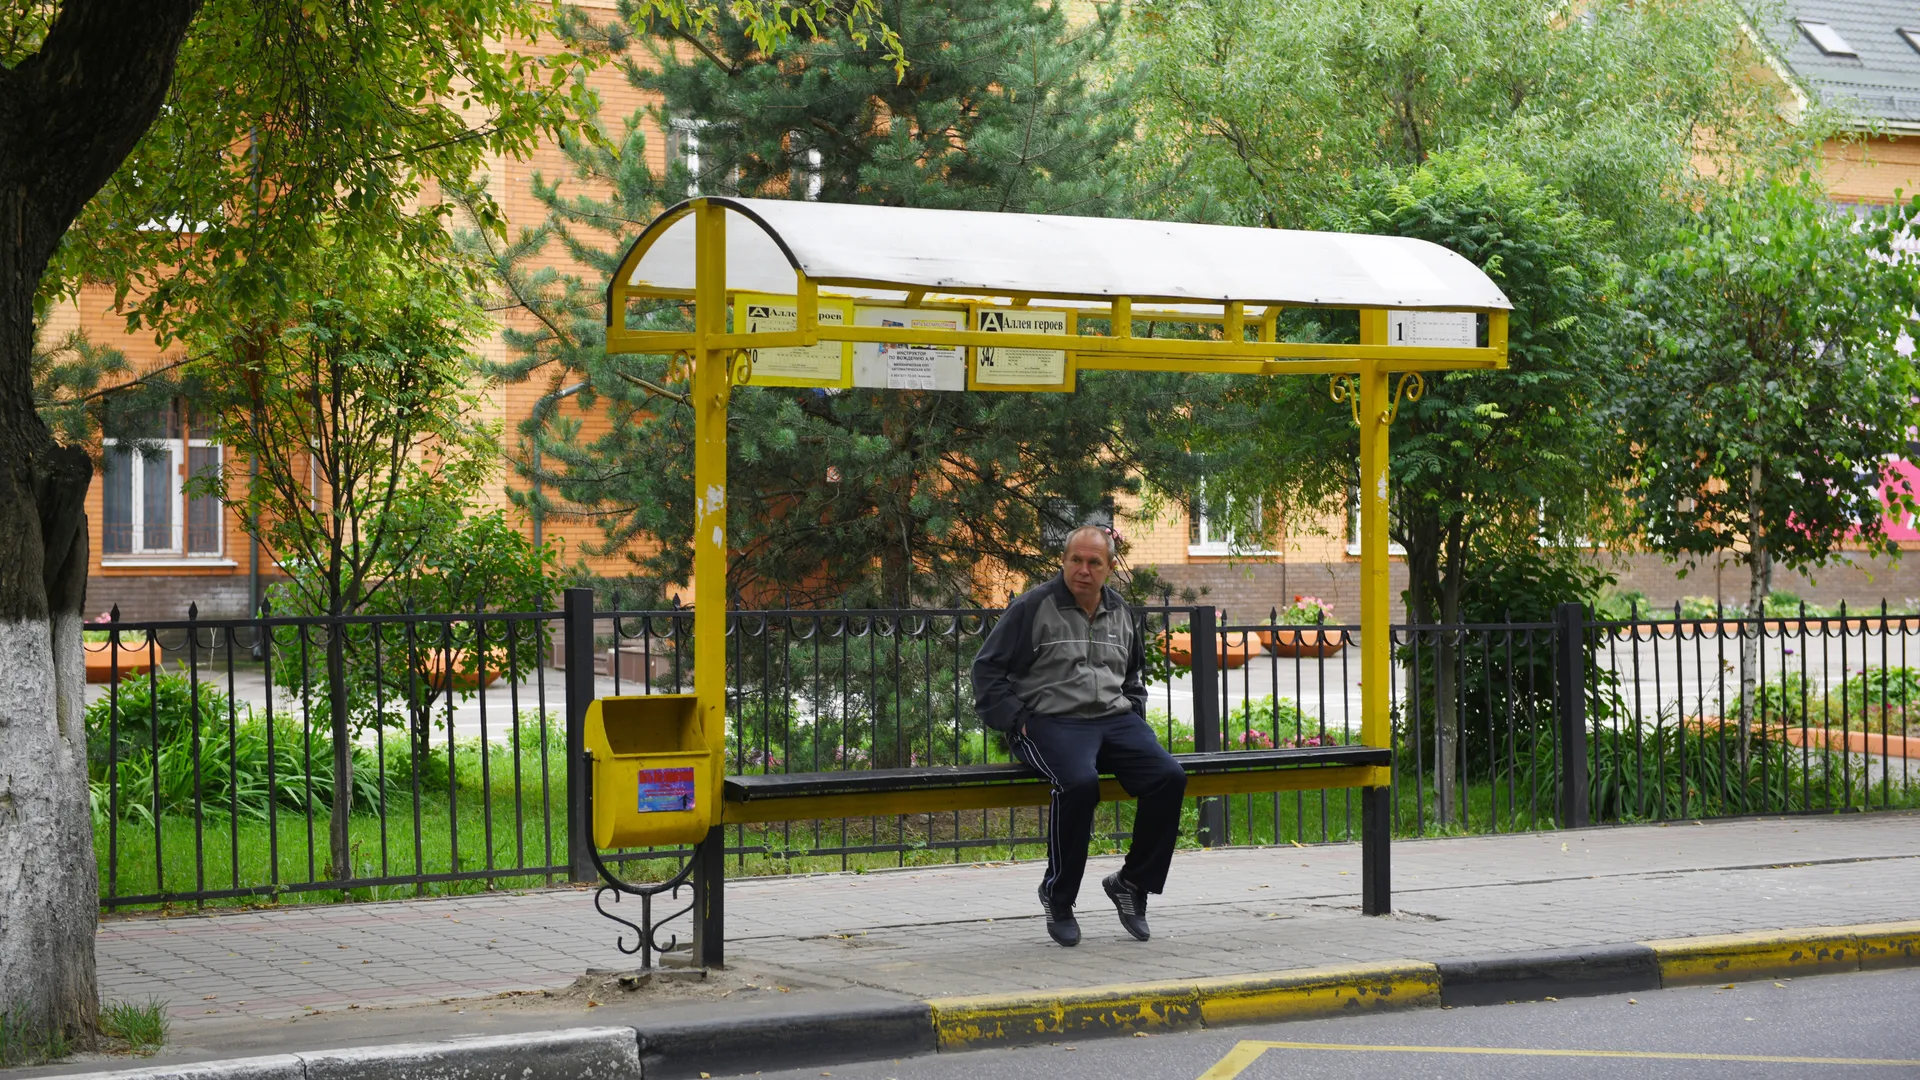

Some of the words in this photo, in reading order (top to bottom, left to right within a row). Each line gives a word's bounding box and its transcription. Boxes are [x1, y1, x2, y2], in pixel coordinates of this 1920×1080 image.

[769, 309, 797, 318] Алле
[818, 312, 842, 321] роев
[1003, 316, 1032, 330] Аллея
[1034, 319, 1064, 333] героев
[1396, 322, 1404, 341] 1
[981, 347, 994, 366] 342
